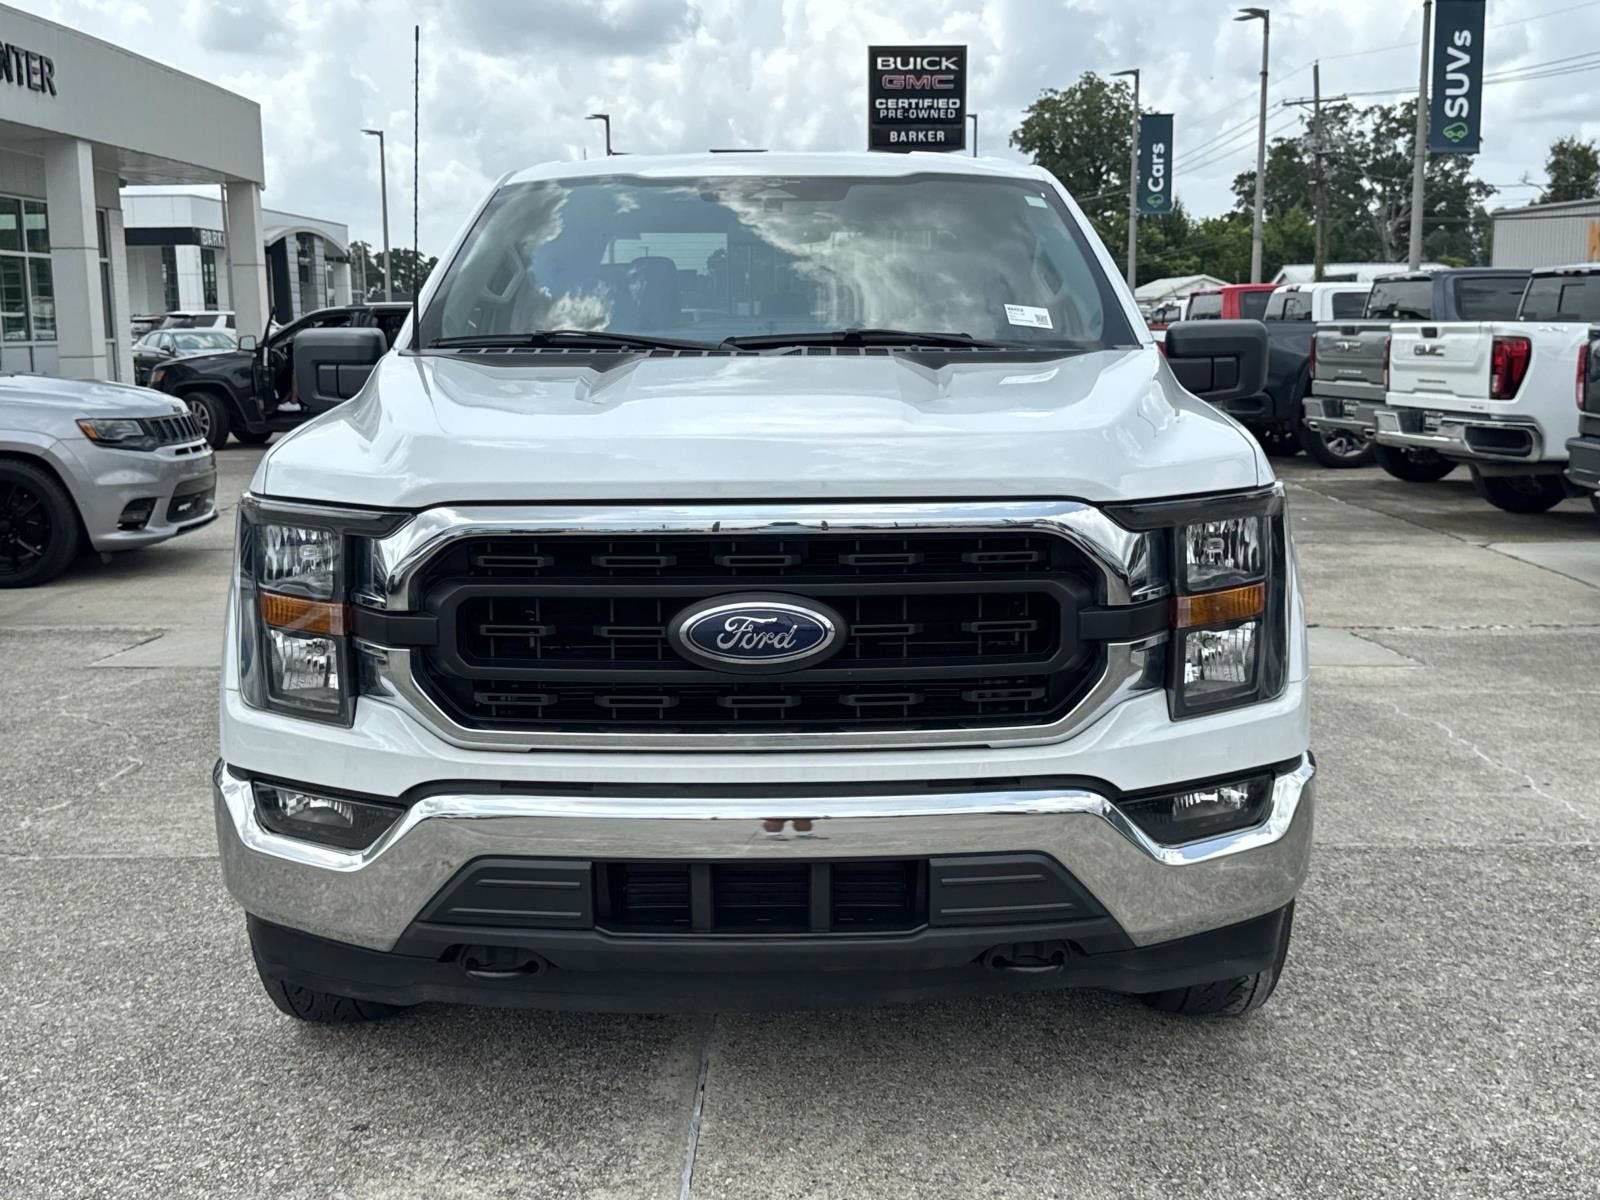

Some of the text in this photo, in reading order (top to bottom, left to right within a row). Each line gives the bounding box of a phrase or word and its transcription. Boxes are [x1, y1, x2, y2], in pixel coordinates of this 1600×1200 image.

[876, 56, 959, 70] BUICK
[1444, 30, 1472, 118] SUVs
[881, 74, 954, 90] GMC
[875, 98, 960, 109] CERTIFIED
[879, 109, 956, 119] PRE-OWNED
[889, 130, 945, 142] BARKER
[1147, 142, 1165, 192] Cars
[716, 616, 798, 650] Ford
